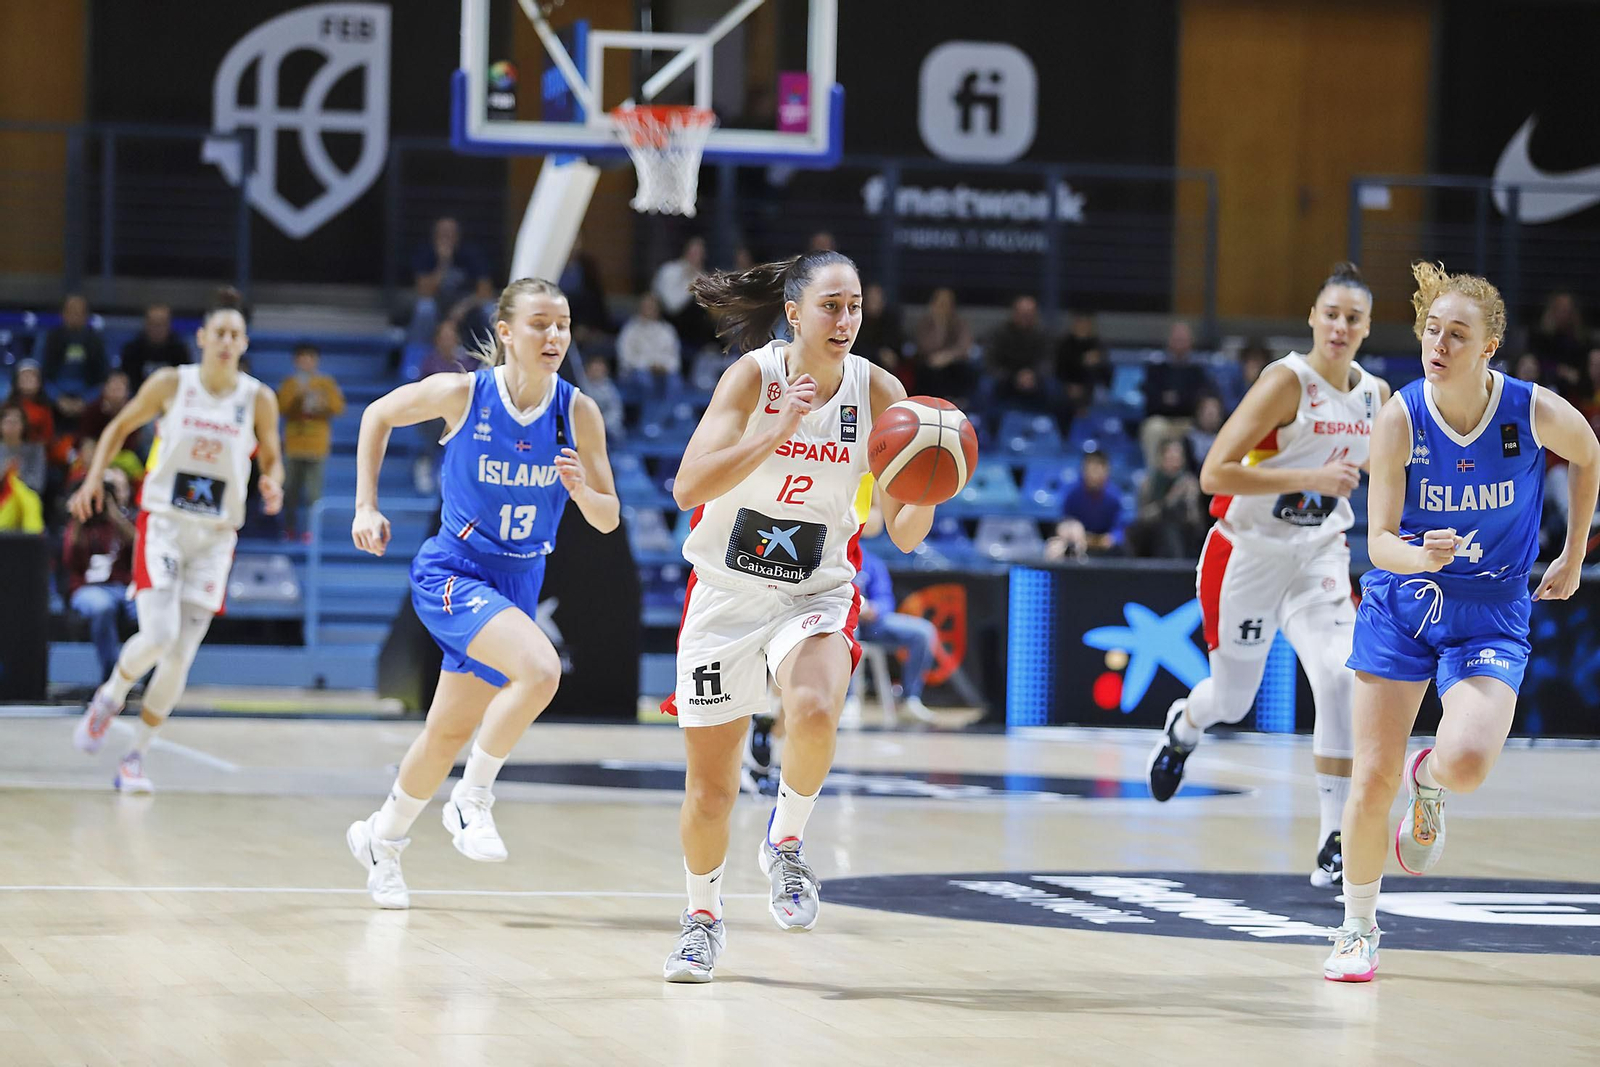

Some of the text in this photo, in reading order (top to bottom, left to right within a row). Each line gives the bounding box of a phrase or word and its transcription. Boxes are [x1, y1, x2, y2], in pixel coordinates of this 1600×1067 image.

[862, 174, 1085, 223] fnetwork
[191, 437, 223, 464] 22
[775, 440, 850, 464] SPAÑA
[478, 454, 560, 488] ÍSLAND
[776, 474, 814, 505] 12
[1419, 478, 1515, 512] ÍSLAND
[499, 504, 537, 540] 13
[1447, 527, 1484, 563] 4
[736, 554, 806, 580] CaixaBank
[1239, 619, 1262, 640] fi
[692, 661, 722, 697] fi
[1466, 657, 1509, 670] Kristall
[689, 693, 731, 706] network
